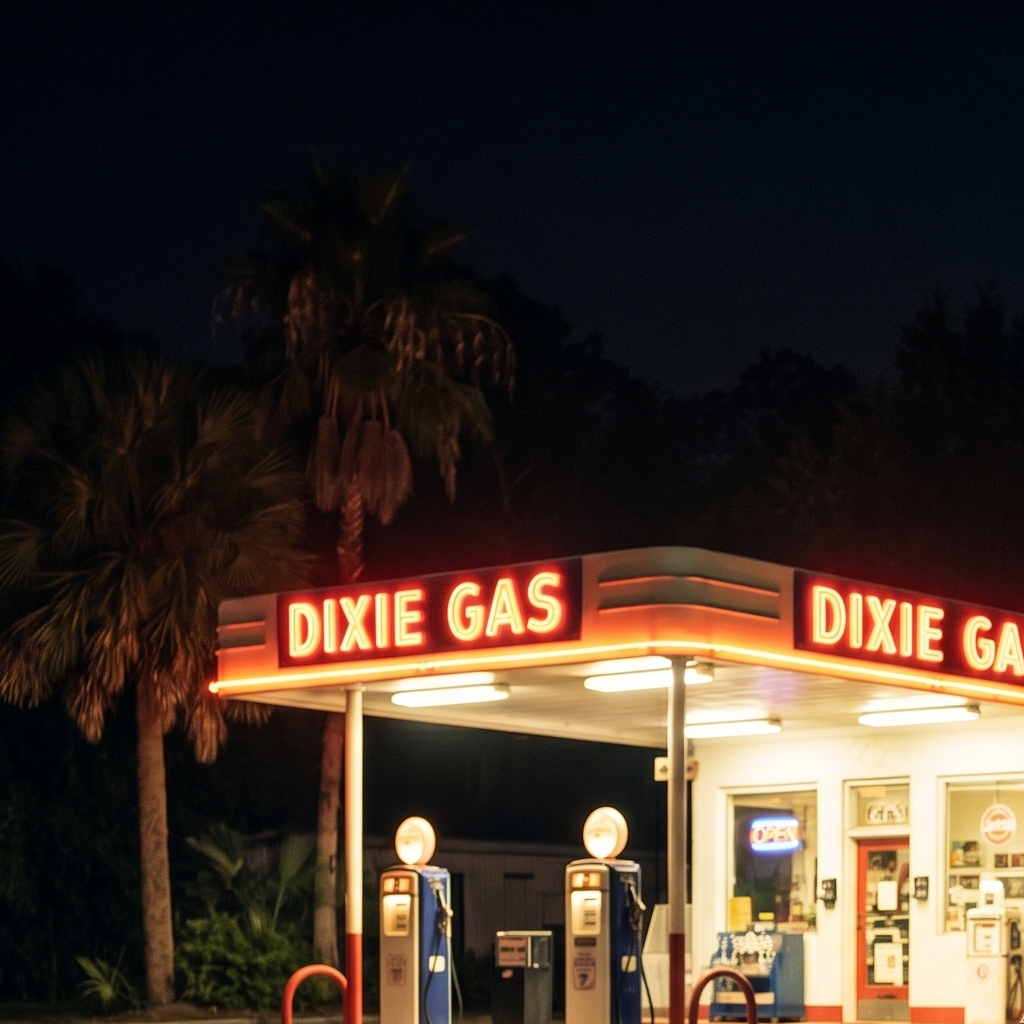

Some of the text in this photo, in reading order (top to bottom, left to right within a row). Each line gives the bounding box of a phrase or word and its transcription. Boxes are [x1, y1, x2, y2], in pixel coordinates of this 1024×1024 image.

[288, 571, 564, 658] DIXIE GAS
[812, 585, 945, 663] DIXIE
[749, 826, 799, 844] OPEN
